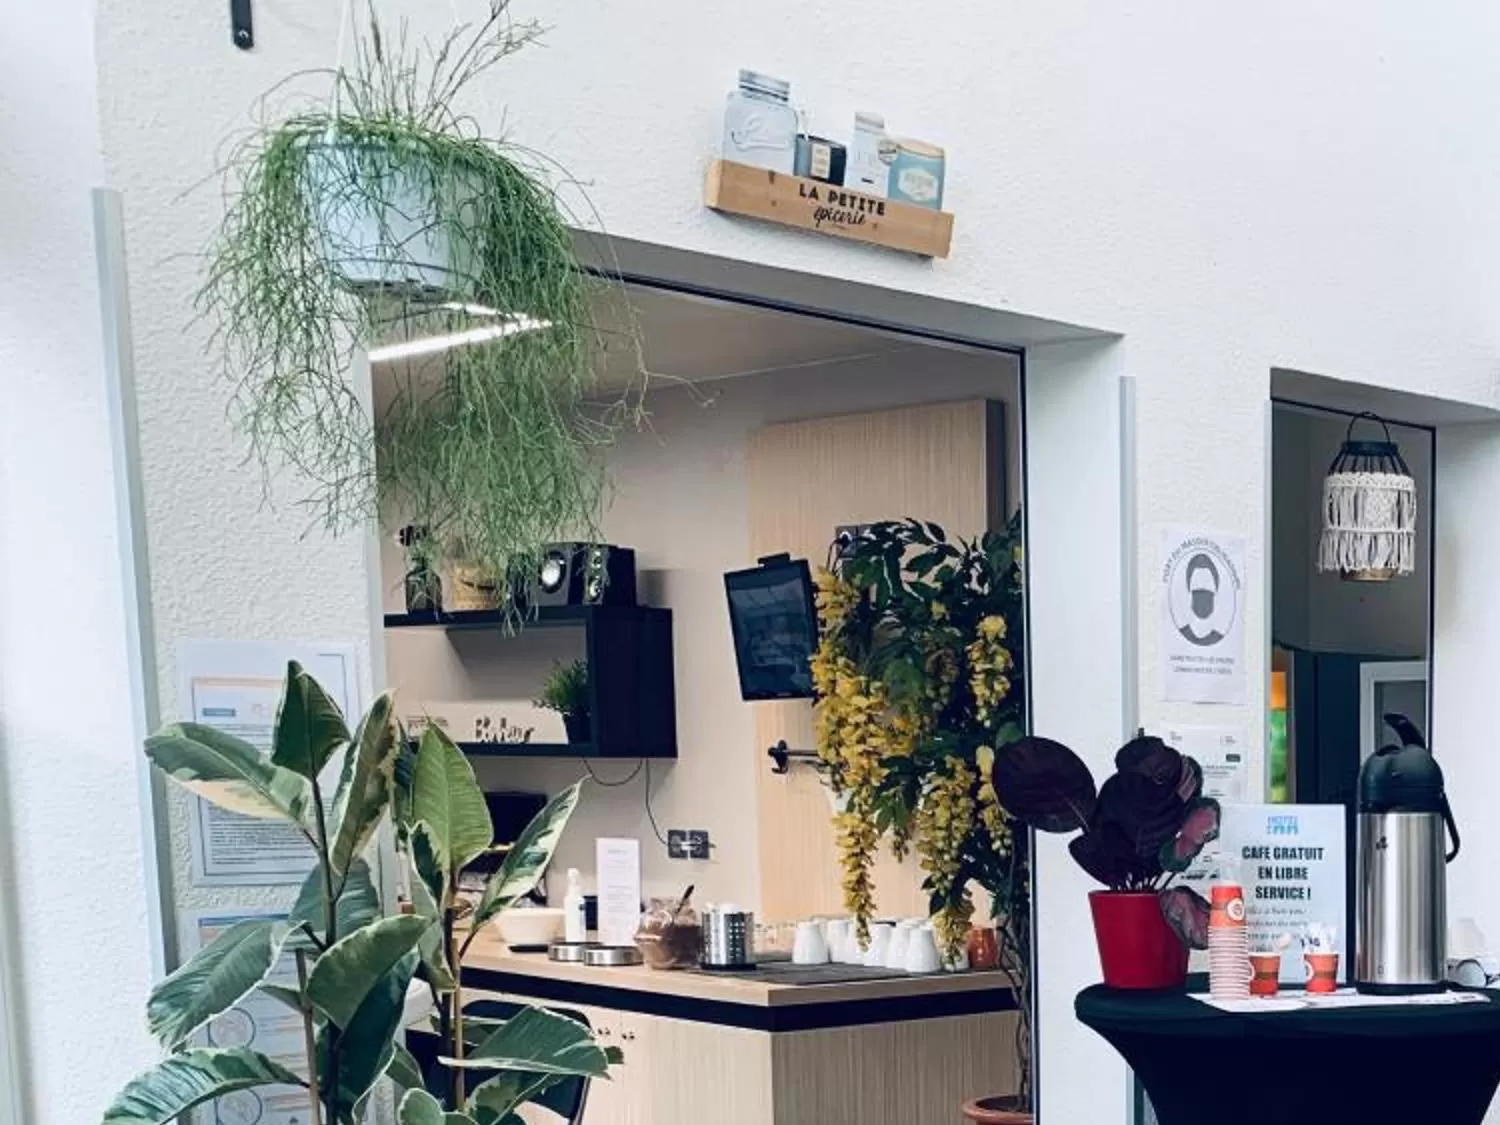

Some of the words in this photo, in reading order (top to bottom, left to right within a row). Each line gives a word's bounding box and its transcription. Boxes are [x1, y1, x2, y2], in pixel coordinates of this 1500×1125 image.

[799, 183, 819, 200] LA
[828, 190, 885, 216] PETITE
[1242, 846, 1270, 860] CAFE
[1273, 847, 1324, 860] GRATUIT
[1258, 866, 1272, 880] EN
[1275, 866, 1309, 880] LIBRE
[1255, 886, 1305, 899] SERVICE
